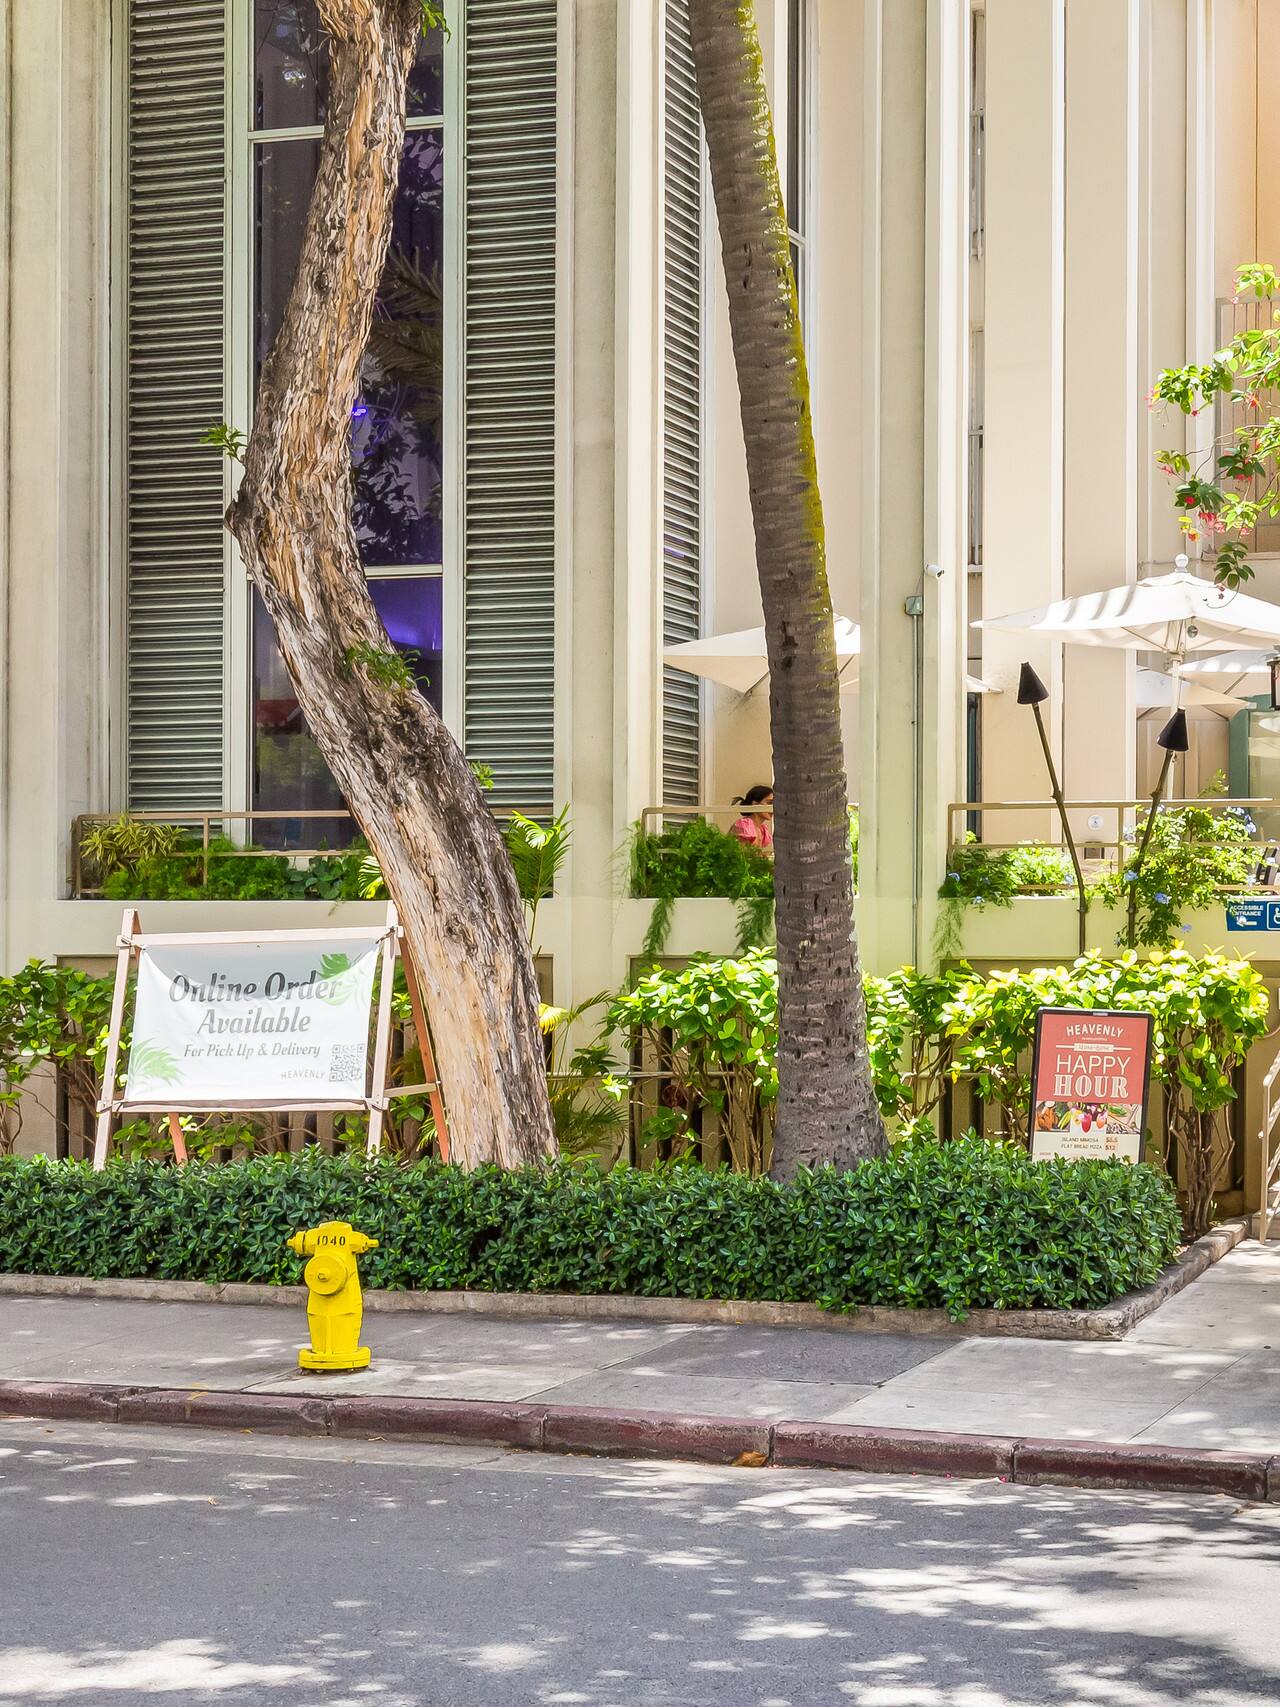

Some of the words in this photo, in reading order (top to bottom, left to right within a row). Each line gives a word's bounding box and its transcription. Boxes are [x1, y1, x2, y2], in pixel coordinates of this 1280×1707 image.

[169, 972, 257, 1002] Online
[264, 970, 344, 1001] Order
[196, 1006, 312, 1034] Available
[1066, 1023, 1124, 1038] HEAVENLY
[183, 1043, 205, 1057] For
[206, 1042, 234, 1057] Pick
[235, 1043, 254, 1059] Up
[257, 1043, 270, 1056] &
[271, 1042, 321, 1059] Delivery
[1055, 1054, 1131, 1075] HAPPY
[280, 1069, 326, 1080] HEAVENLY
[1053, 1074, 1129, 1099] HOUR
[317, 1235, 346, 1247] 1040
